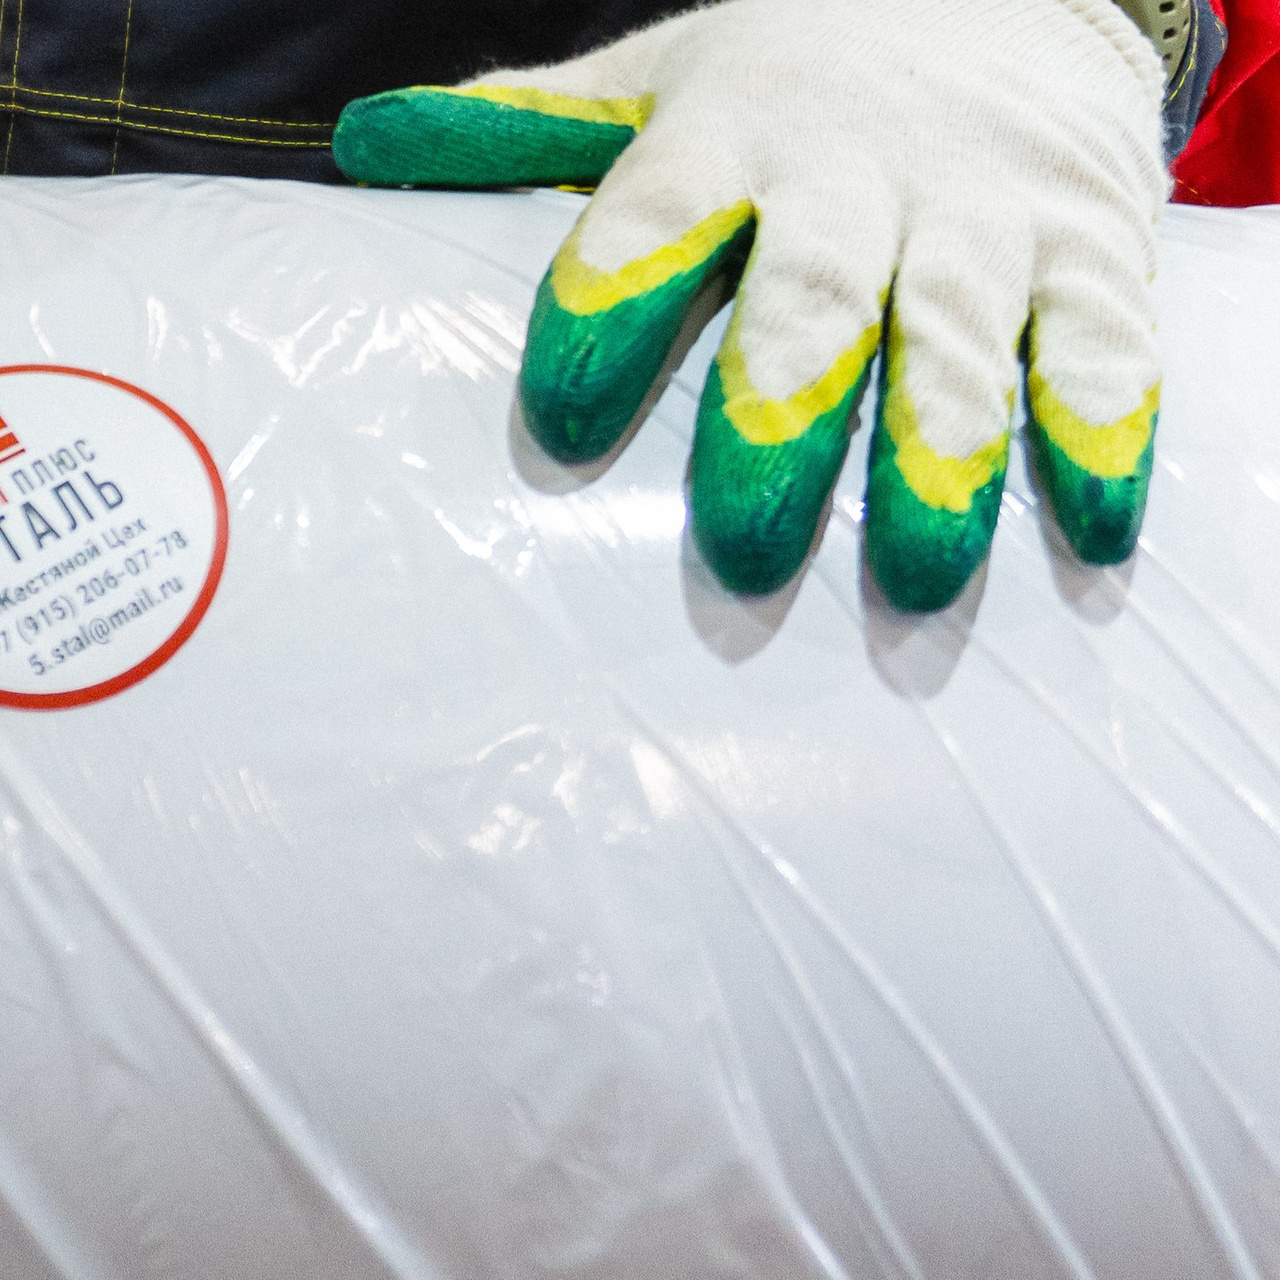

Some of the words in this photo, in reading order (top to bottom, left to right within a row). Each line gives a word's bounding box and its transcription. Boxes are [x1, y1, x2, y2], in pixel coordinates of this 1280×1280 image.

[11, 439, 95, 495] ПЛЮС
[101, 518, 147, 549] Цех
[15, 594, 76, 645] (915)
[76, 530, 188, 606] 206-07-78
